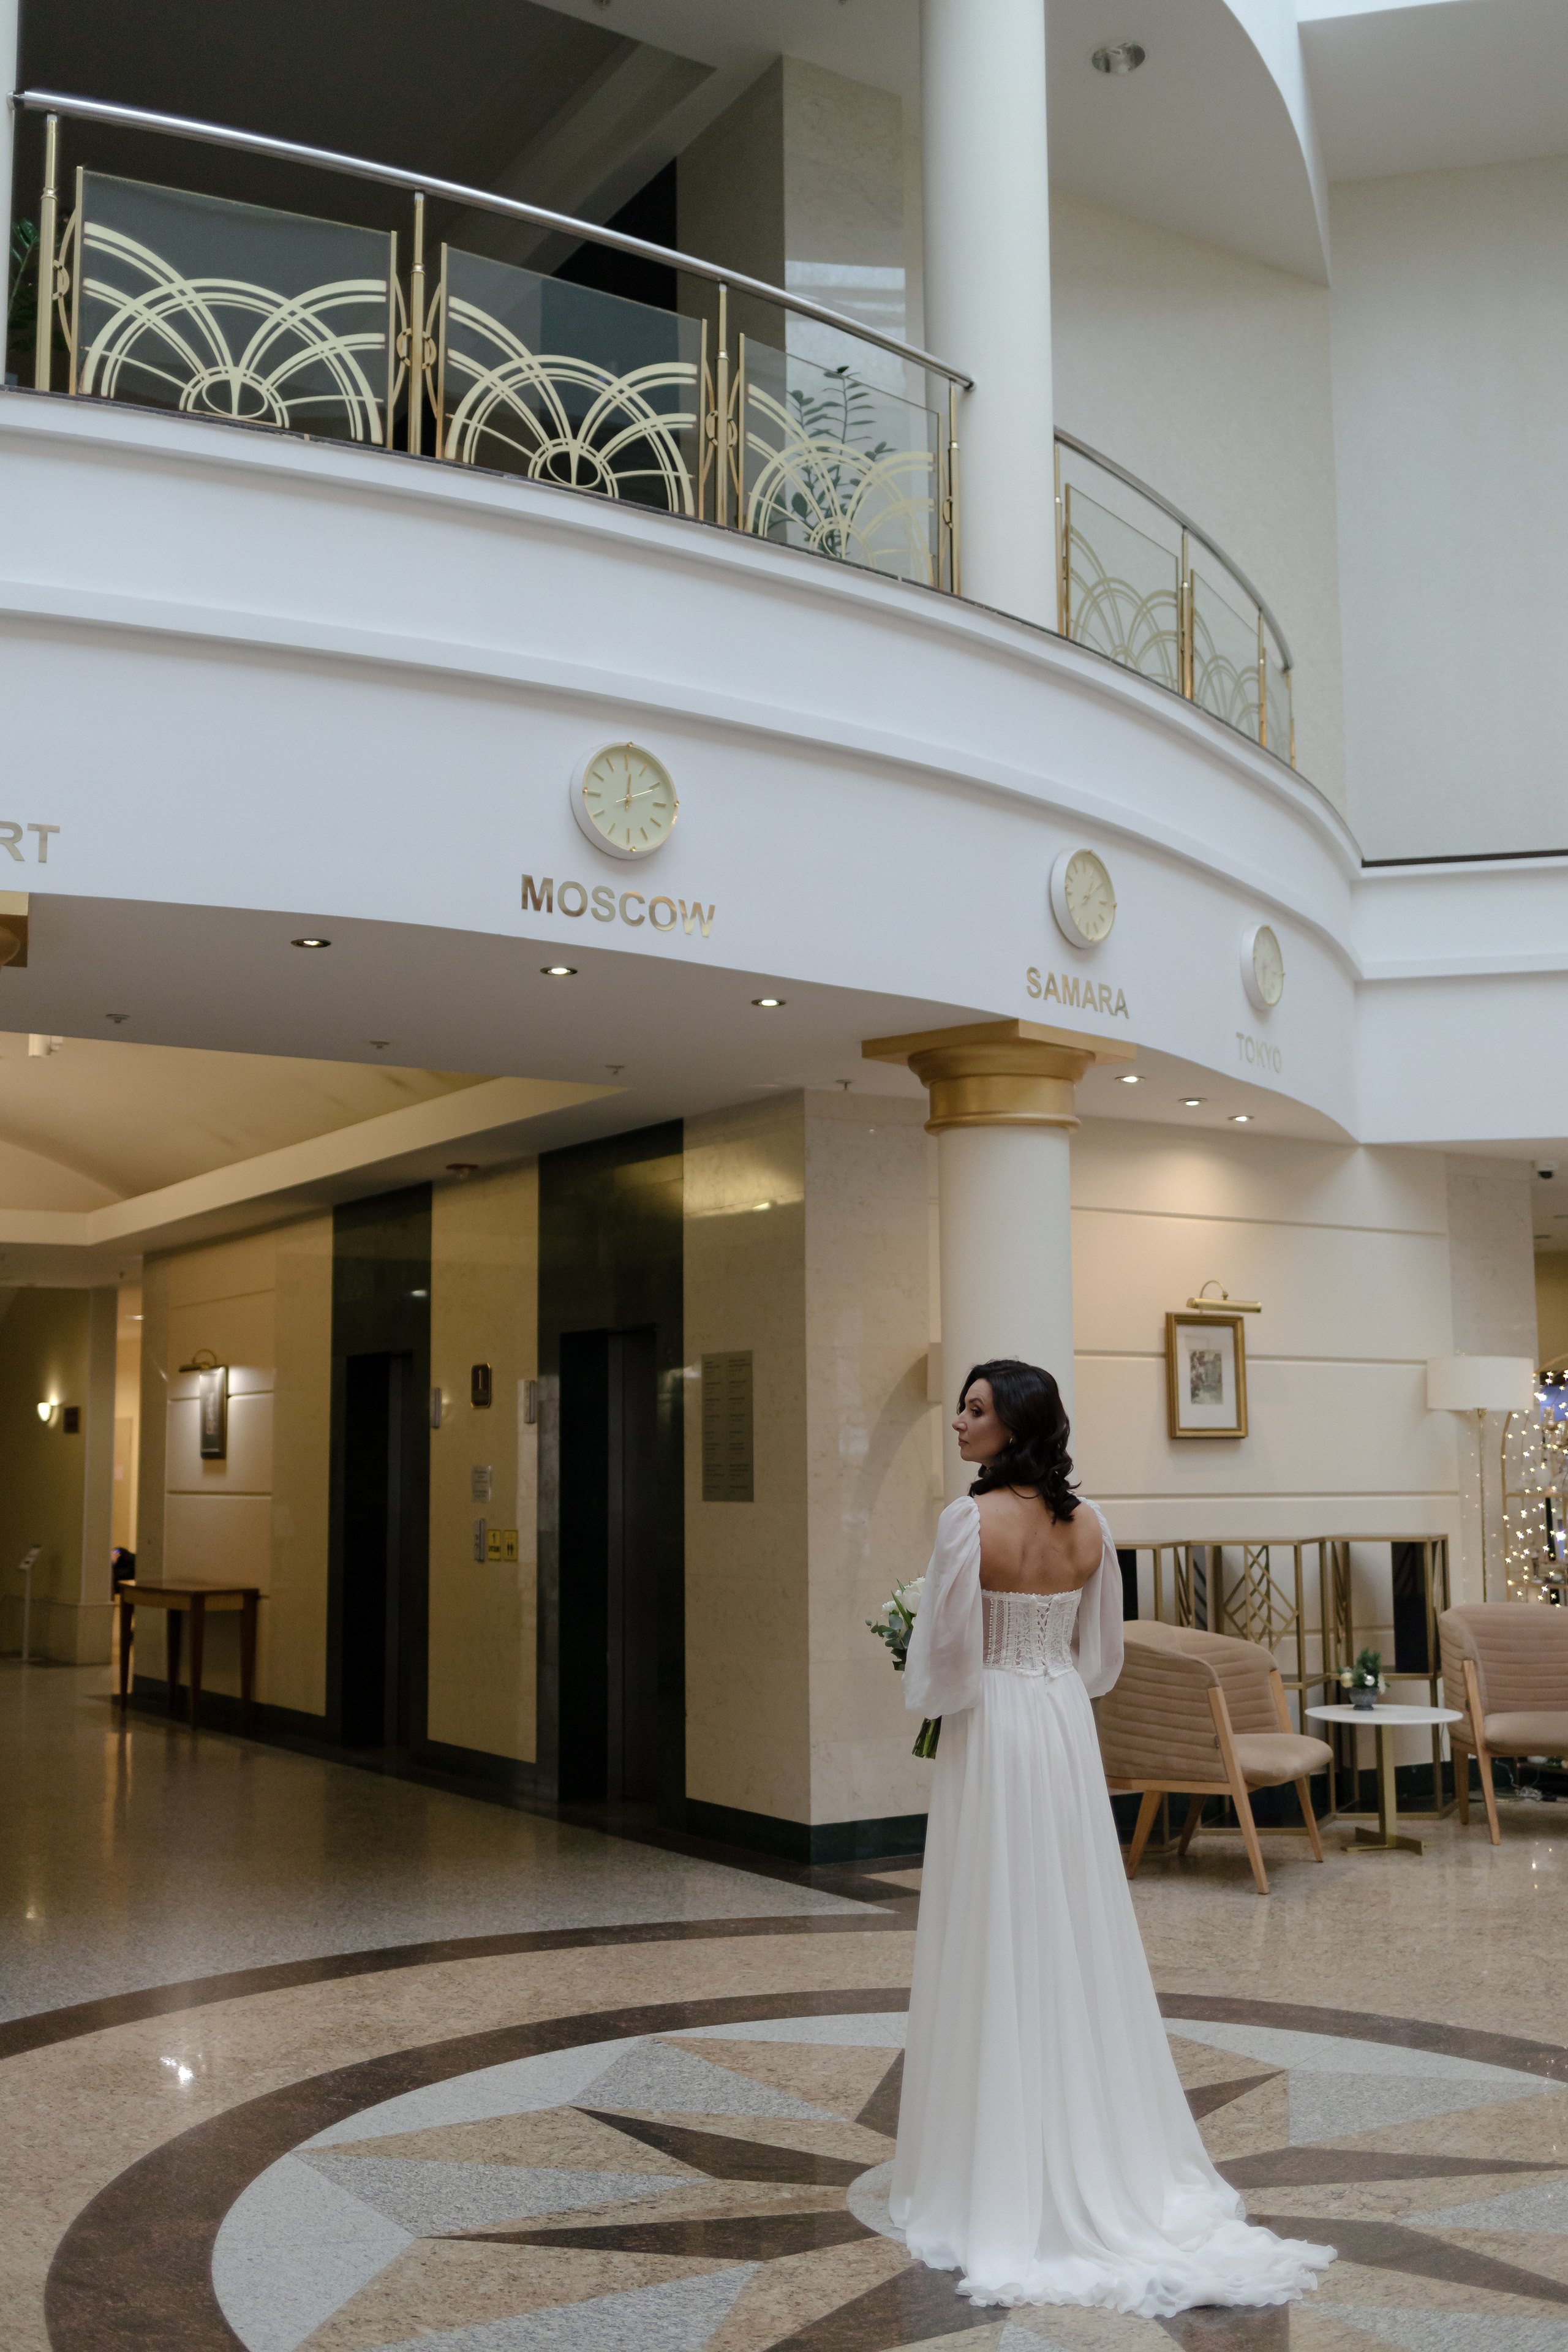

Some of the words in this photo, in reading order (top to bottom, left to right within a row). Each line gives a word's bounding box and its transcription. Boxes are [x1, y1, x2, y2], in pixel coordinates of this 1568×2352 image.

[0, 821, 60, 863] RT
[521, 874, 715, 937] MOSCOW
[1027, 967, 1129, 1019] SAMARA
[1236, 1032, 1282, 1073] TOKYO
